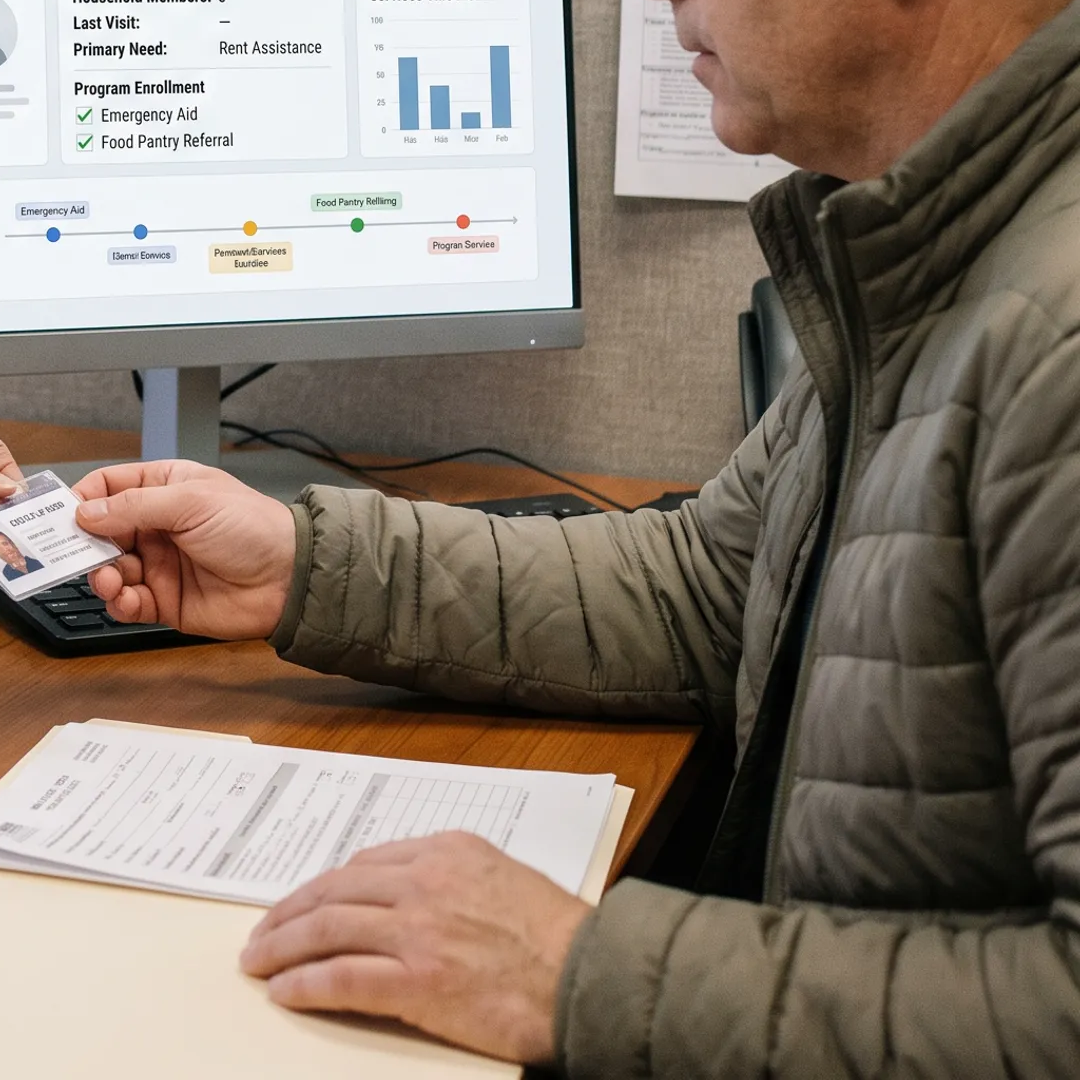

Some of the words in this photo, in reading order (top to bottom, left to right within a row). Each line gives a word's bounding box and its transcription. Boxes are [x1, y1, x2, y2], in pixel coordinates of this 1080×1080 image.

[73, 15, 102, 30] Last
[105, 14, 140, 30] Visit:
[73, 41, 126, 60] Primary
[129, 40, 167, 56] Need:
[219, 40, 249, 55] Rent
[251, 40, 322, 55] Assistance
[74, 81, 131, 99] Program
[134, 79, 206, 95] Enrollment
[101, 108, 173, 126] Emergency
[176, 106, 198, 121] Aid
[101, 133, 134, 150] Food
[138, 134, 180, 152] Pantry
[183, 131, 234, 148] Referral
[20, 206, 69, 218] Emergency
[69, 205, 85, 215] Aid
[316, 198, 337, 207] Food
[338, 197, 365, 208] Pantry
